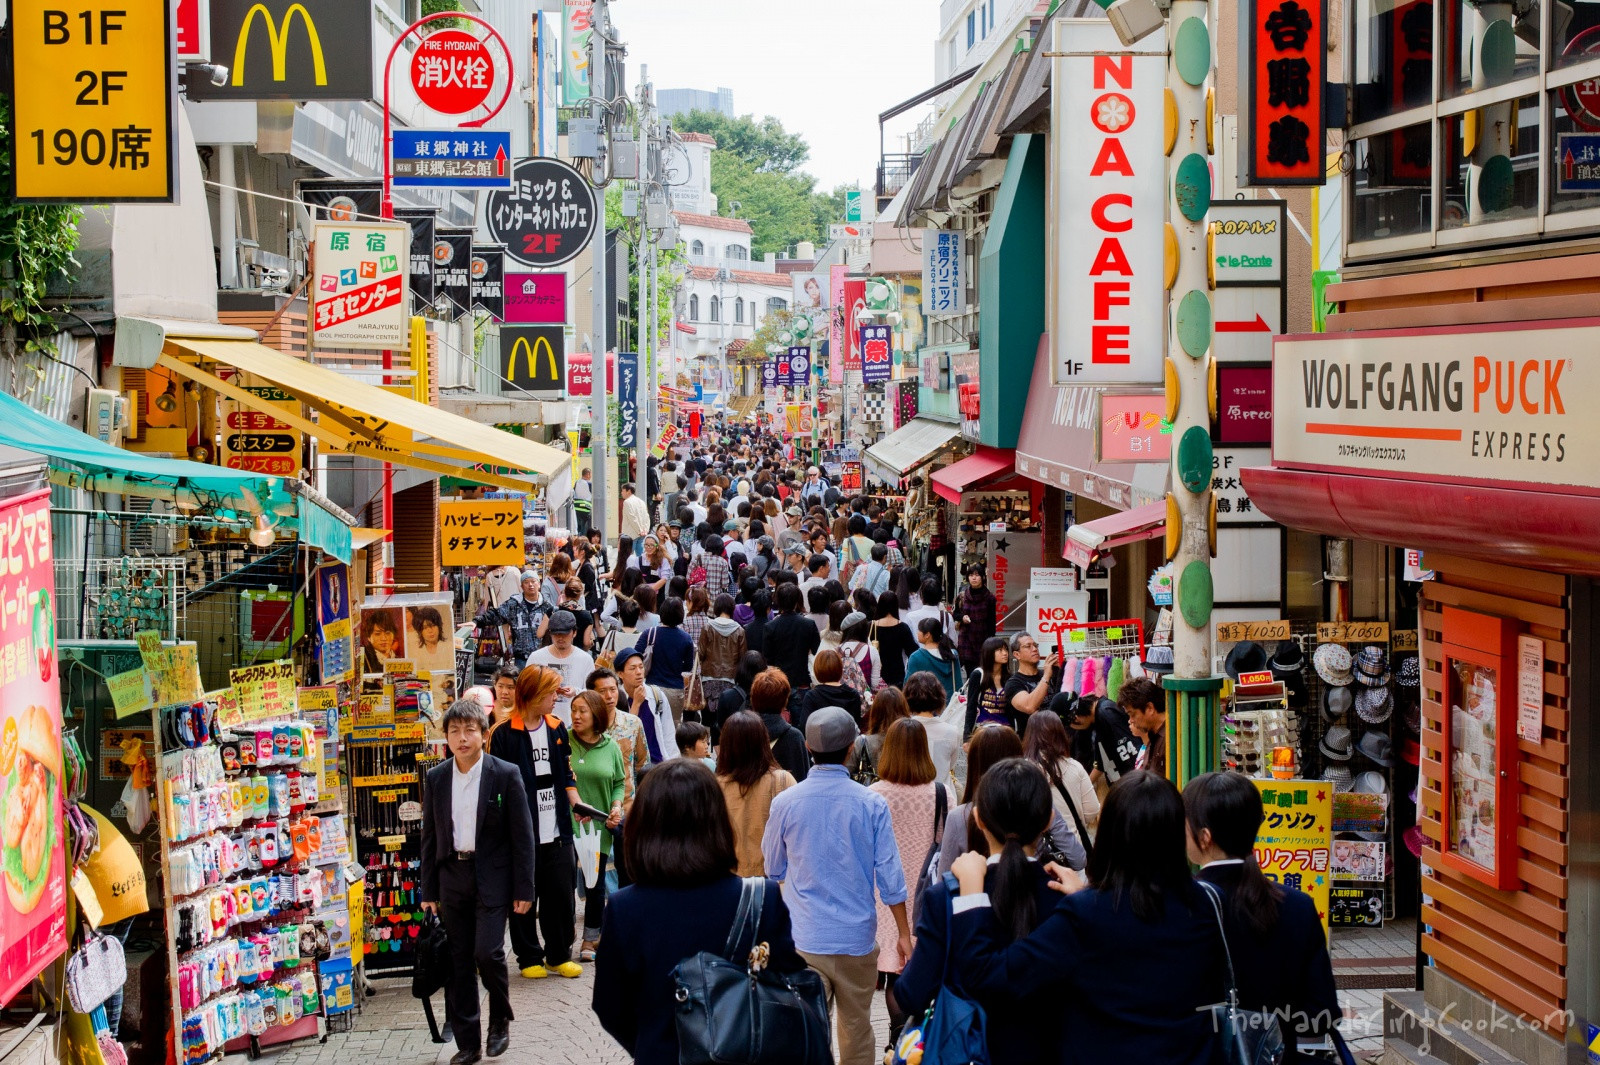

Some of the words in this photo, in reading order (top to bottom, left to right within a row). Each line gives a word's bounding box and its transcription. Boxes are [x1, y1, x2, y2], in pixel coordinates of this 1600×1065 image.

[43, 10, 127, 46] B1F
[424, 41, 442, 51] FIRE
[444, 41, 481, 52] HYDRANT
[418, 55, 489, 90] 消火栓
[75, 70, 129, 107] 2F
[30, 124, 153, 172] 190席
[414, 140, 489, 157] 東郷神社
[414, 160, 493, 177] 東郷記念館
[508, 179, 557, 202] コミック
[561, 178, 573, 200] &
[495, 202, 588, 231] インターネットカフェ
[329, 231, 387, 253] 原宿
[522, 233, 562, 255] 2F
[1241, 254, 1273, 268] Ponte
[321, 256, 398, 292] アイドル
[434, 274, 469, 287] PHA
[938, 233, 950, 311] 原宿クリニック
[1088, 192, 1135, 365] CAFE
[524, 284, 535, 292] 6F
[316, 283, 401, 328] 写真センター
[358, 323, 400, 331] HARAJYUKU
[863, 338, 889, 364] 祭
[1064, 359, 1084, 376] 1F
[1301, 358, 1464, 413] WOLFGANG
[1472, 355, 1567, 415] PUCK
[235, 413, 289, 429] 生写真
[232, 436, 291, 451] ポスター
[1471, 429, 1567, 463] EXPRESS
[1211, 476, 1243, 490] 炭火
[444, 511, 519, 528] ハッピーワン
[1038, 607, 1078, 621] NOA
[1243, 623, 1285, 642] ¥1050
[1343, 623, 1383, 640] ¥1050
[1116, 741, 1139, 762] 24
[1364, 896, 1383, 926] 3
